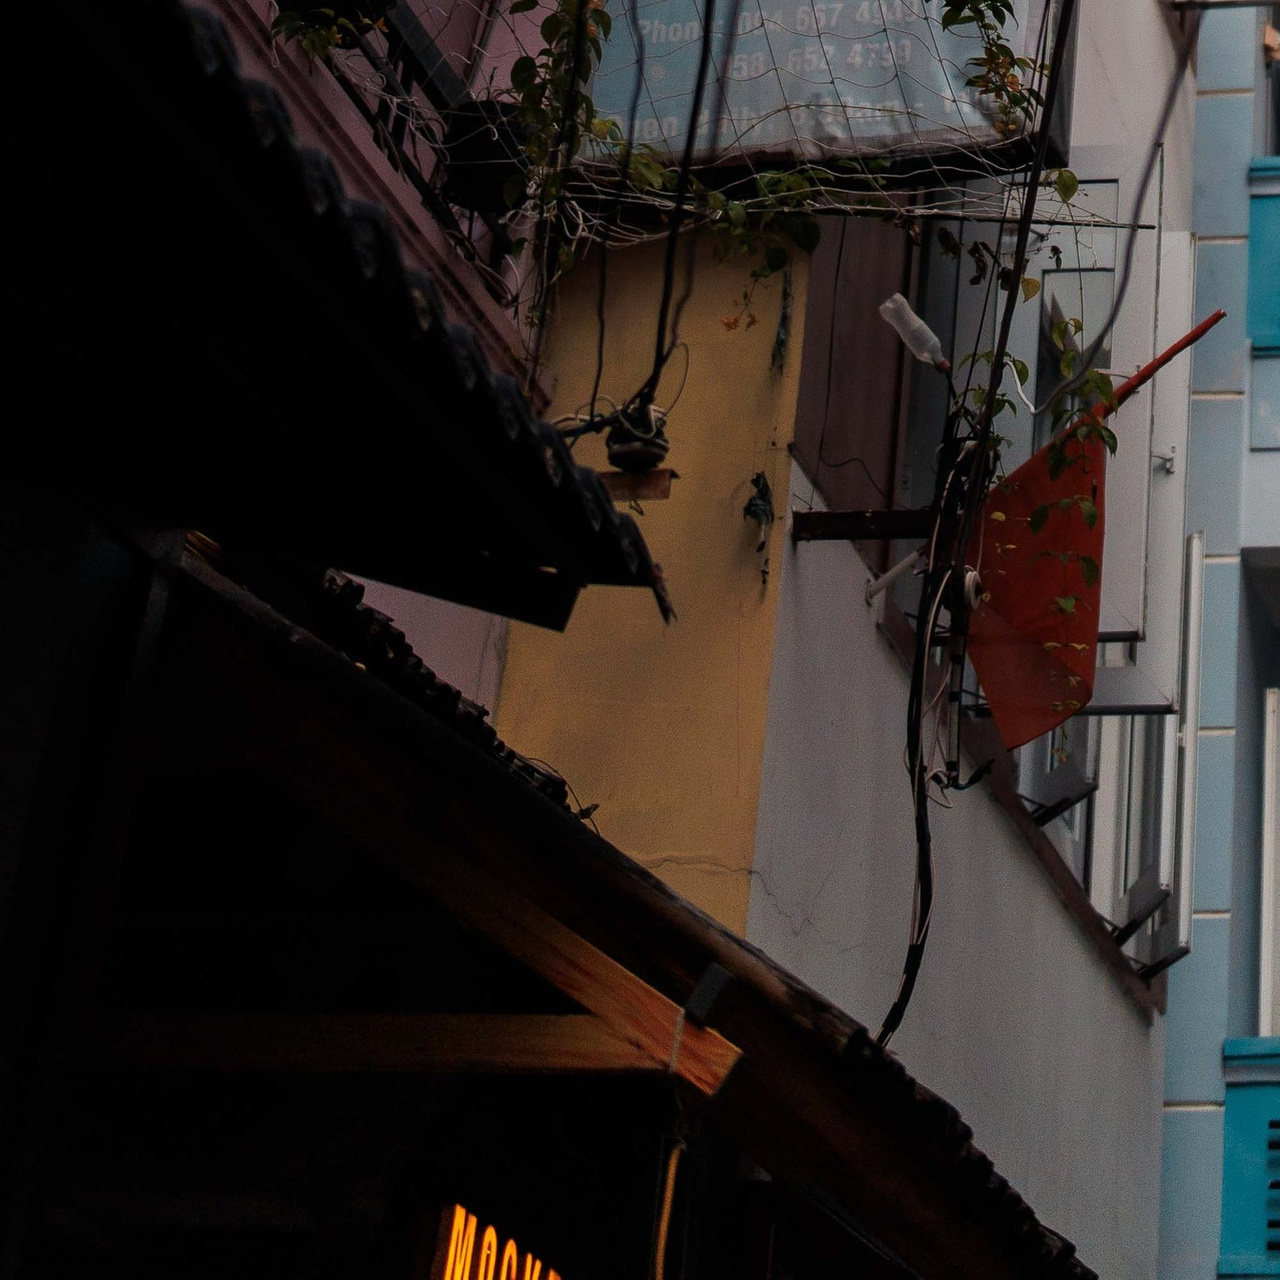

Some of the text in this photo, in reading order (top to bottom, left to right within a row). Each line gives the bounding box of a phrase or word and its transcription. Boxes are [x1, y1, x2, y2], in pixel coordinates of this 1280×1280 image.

[637, 18, 723, 44] Phon:
[795, 2, 844, 31] 667
[723, 51, 766, 81] 58
